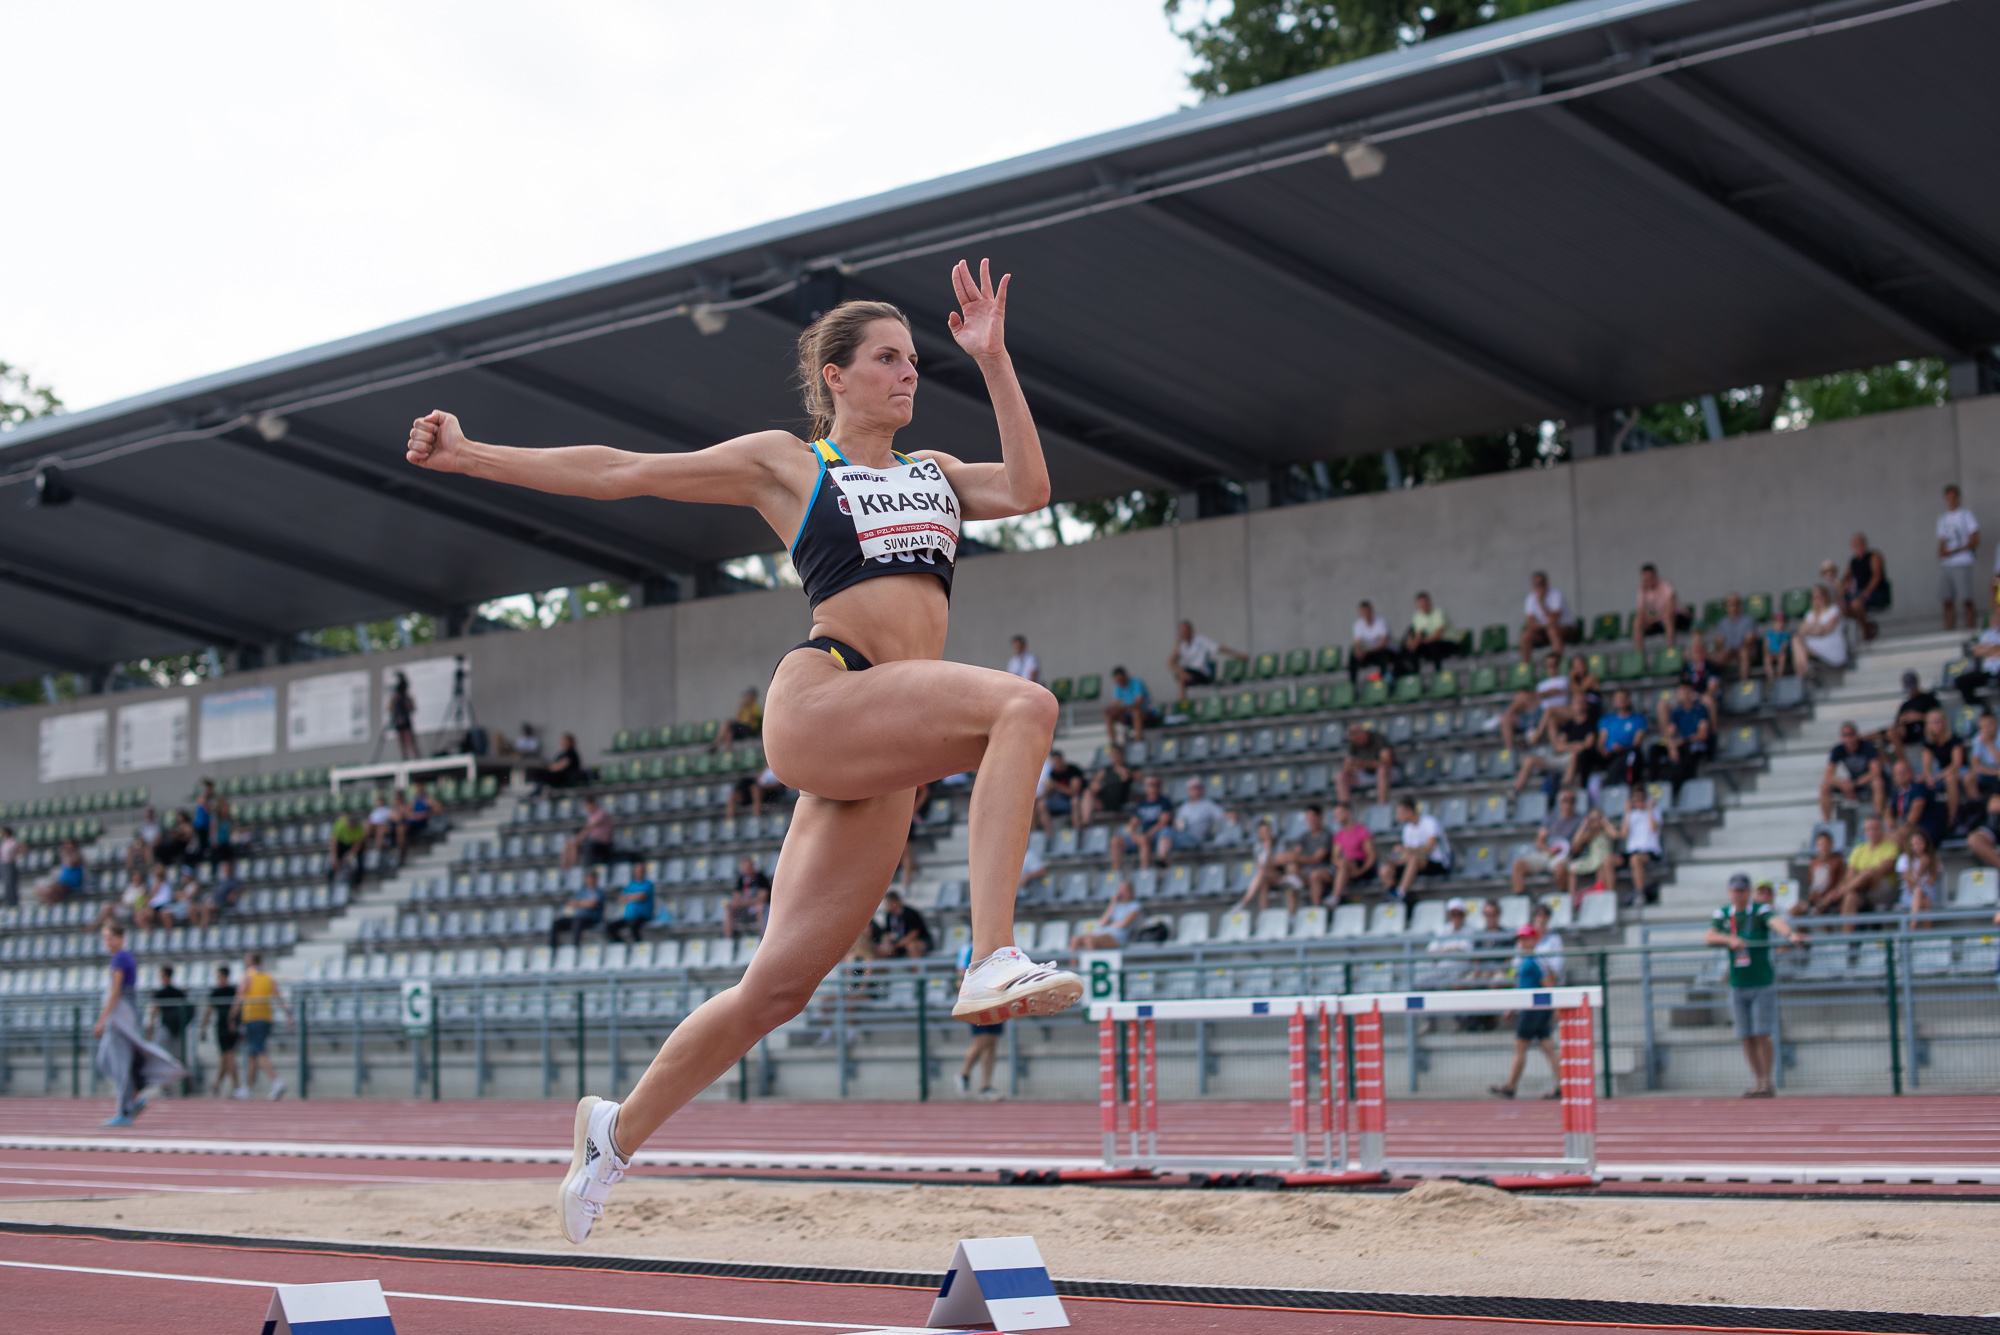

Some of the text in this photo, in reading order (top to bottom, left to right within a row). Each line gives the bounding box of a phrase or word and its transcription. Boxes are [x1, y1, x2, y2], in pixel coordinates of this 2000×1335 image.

[909, 463, 941, 481] 43
[857, 492, 957, 519] KRASKA
[876, 527, 896, 536] PZLA
[1091, 960, 1112, 998] B
[408, 987, 423, 1020] C
